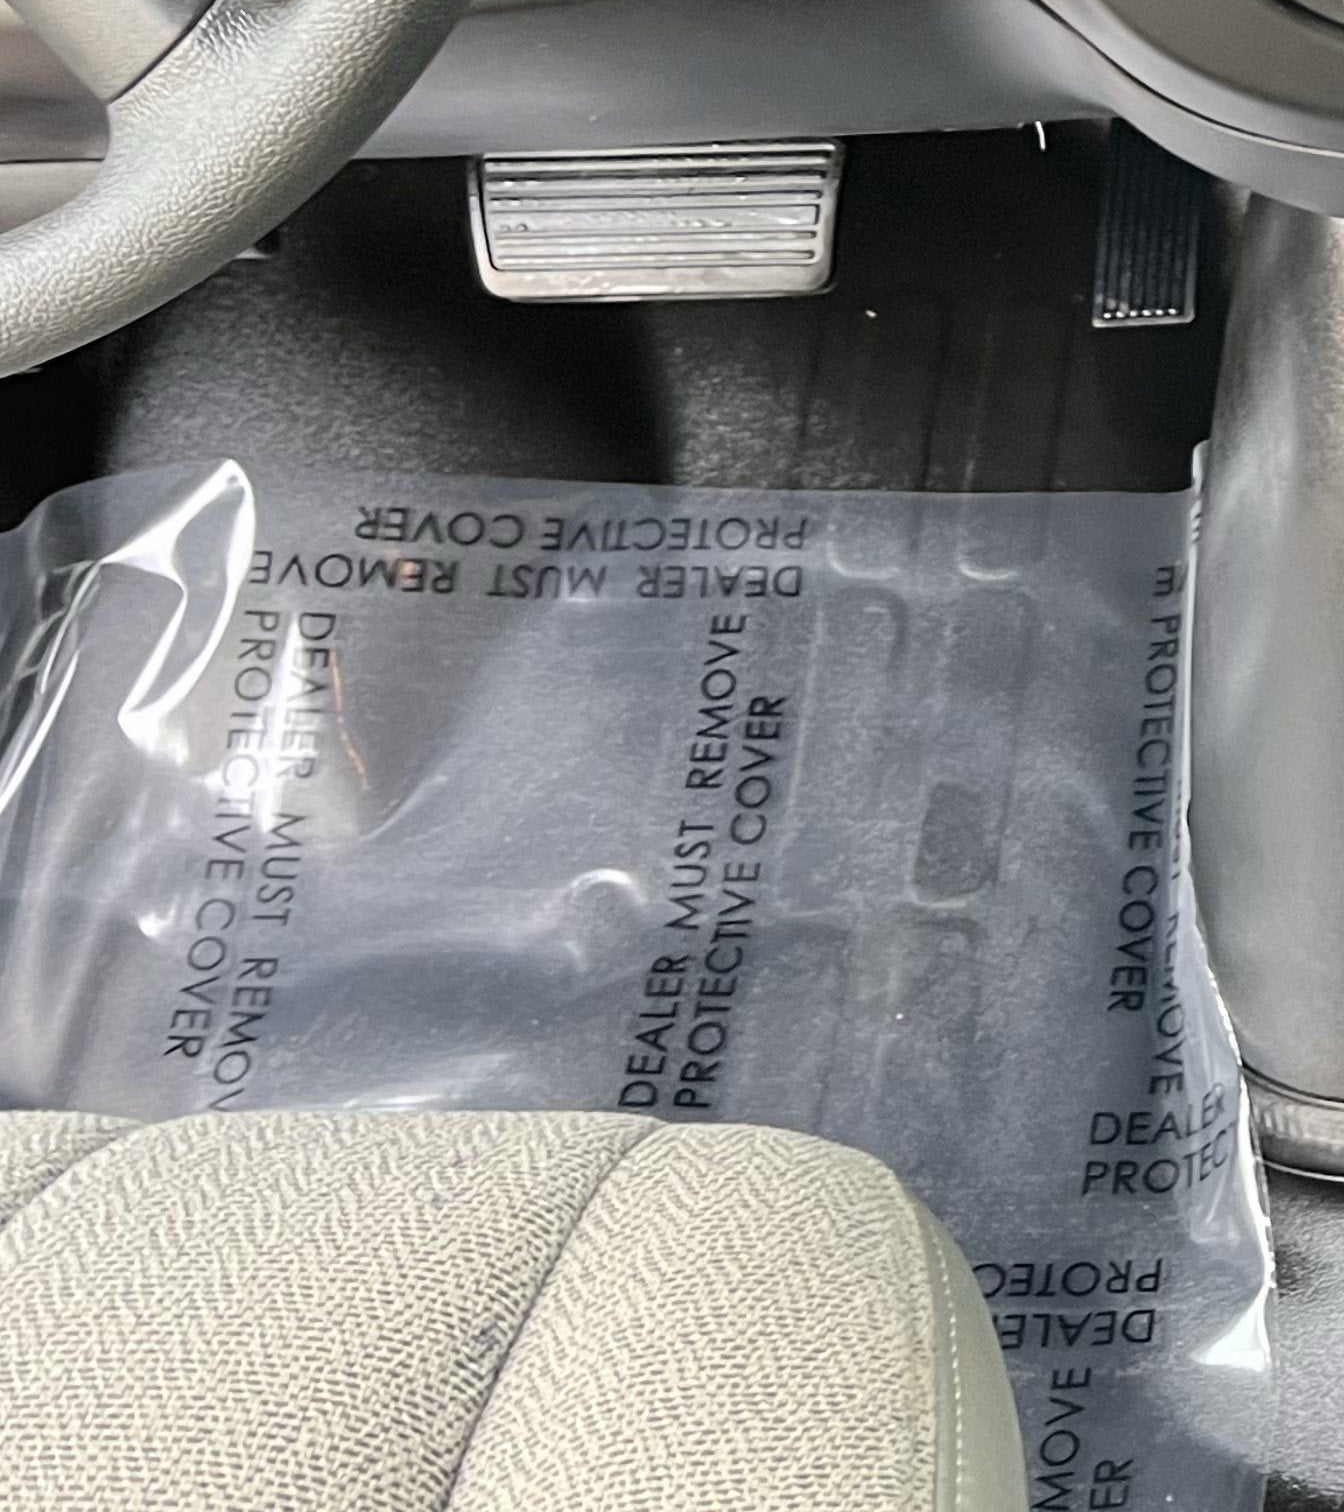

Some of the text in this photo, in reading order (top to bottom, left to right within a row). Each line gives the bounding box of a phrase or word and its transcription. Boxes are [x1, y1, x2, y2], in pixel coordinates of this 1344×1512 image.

[250, 549, 804, 600] DEALER MUST REMOVE
[354, 504, 809, 552] PROTECTIVE COVER
[276, 609, 338, 782] DEALER
[159, 608, 281, 1060] PROTECTIVE COVER
[252, 813, 308, 928] MUST
[617, 612, 750, 1110] DEALER MUST REMOVE
[1105, 612, 1182, 1014] PROTECTIVE COVER
[672, 694, 791, 1109] PROTECTIVE COVER
[994, 1308, 1158, 1351] DEALE
